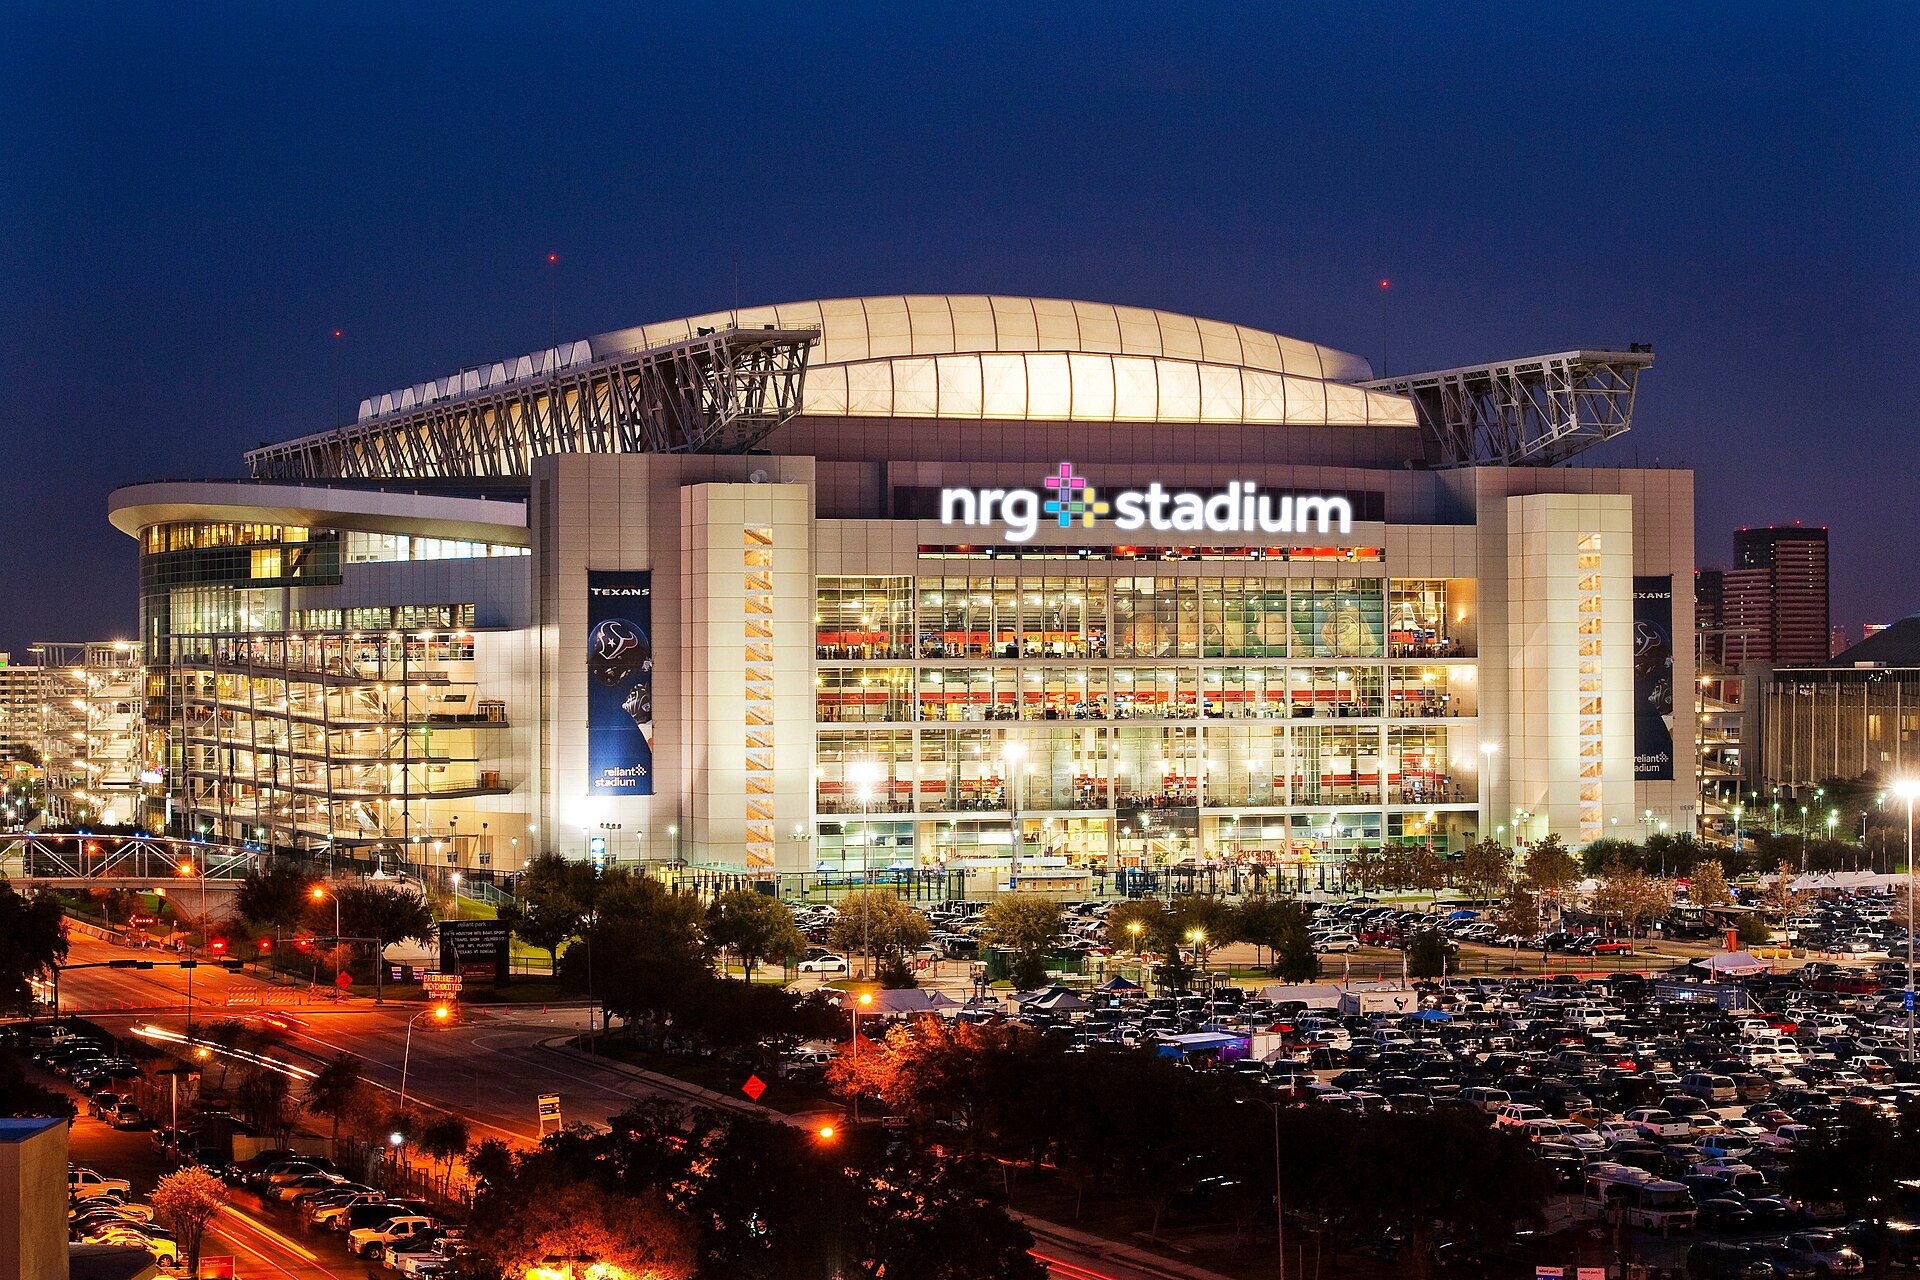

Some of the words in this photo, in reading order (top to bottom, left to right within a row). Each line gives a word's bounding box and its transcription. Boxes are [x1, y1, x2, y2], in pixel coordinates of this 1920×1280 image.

[941, 486, 1040, 542] nrg
[1114, 480, 1353, 534] stadium
[590, 587, 650, 597] TEXANS
[1634, 754, 1660, 763] reliant
[604, 766, 637, 777] reliant
[1634, 763, 1660, 772] adium
[594, 777, 636, 787] stadium
[1906, 999, 1914, 1007] 23
